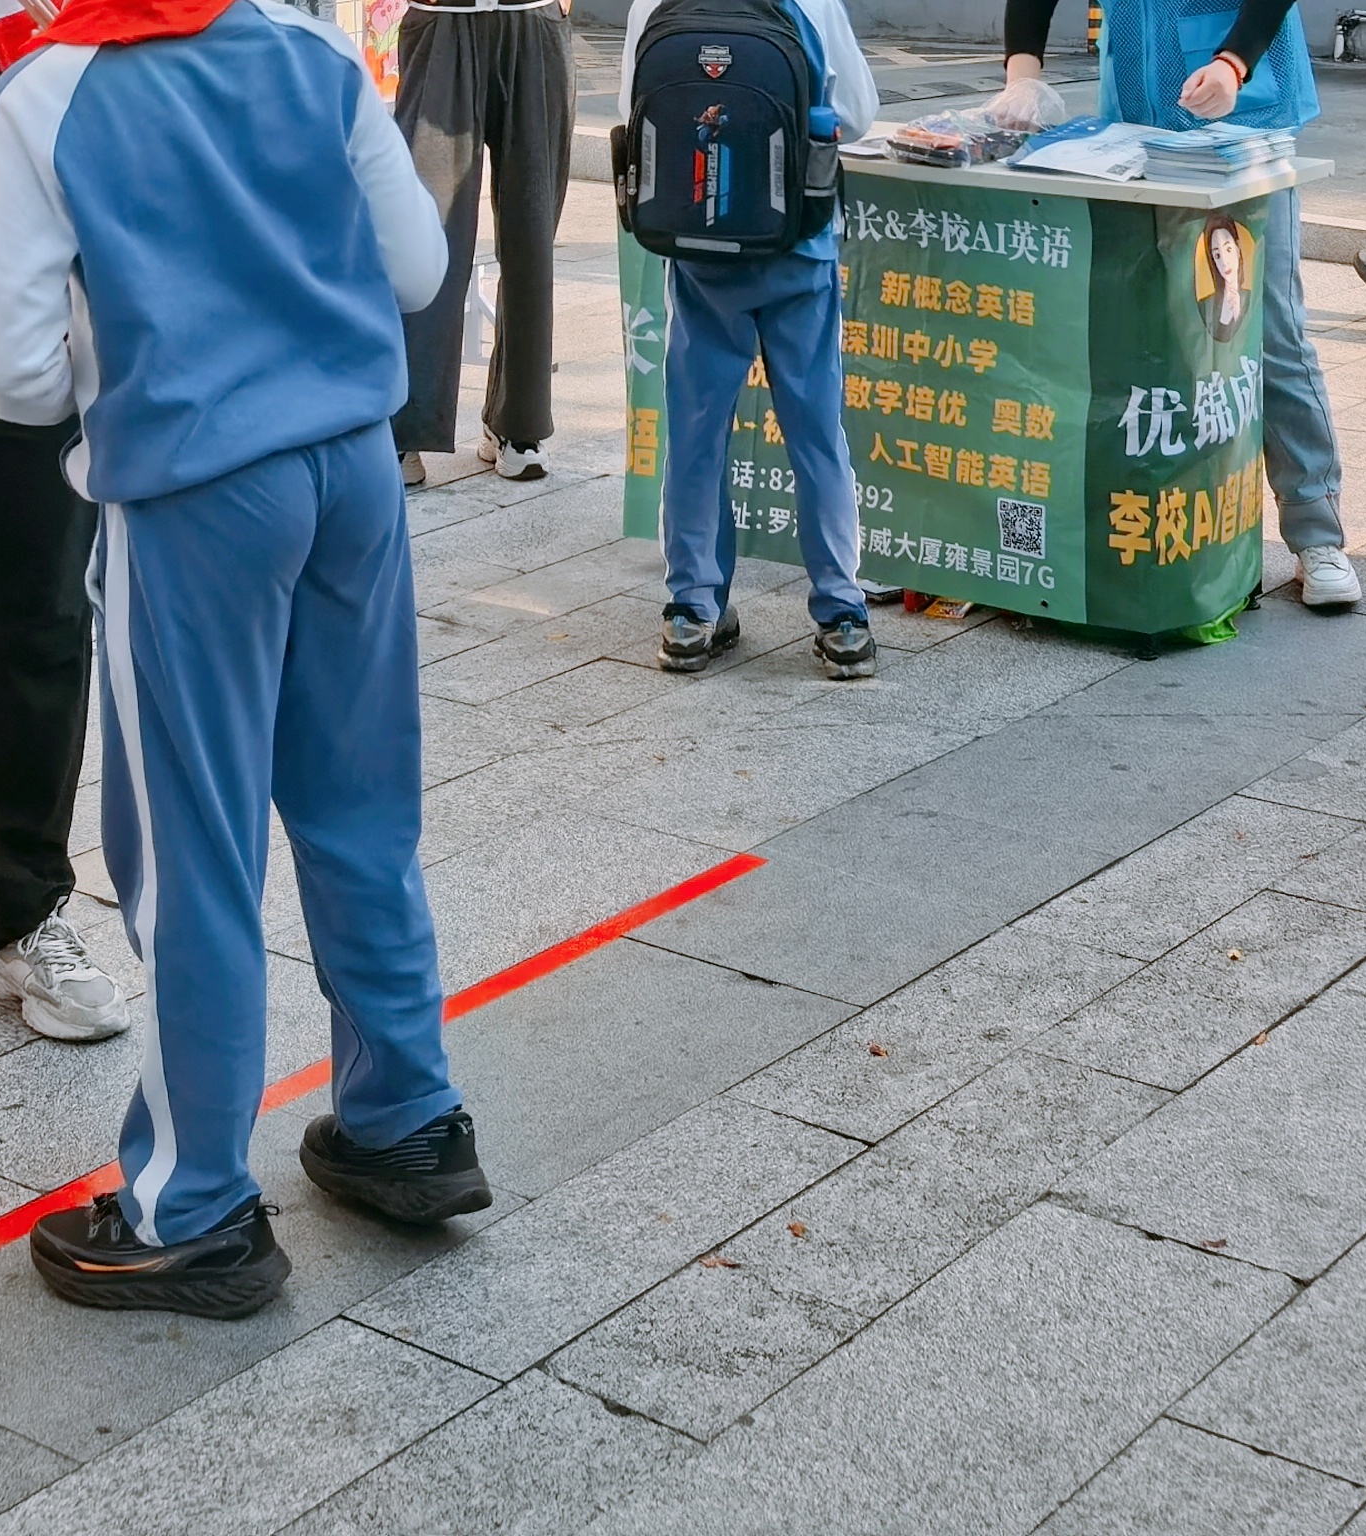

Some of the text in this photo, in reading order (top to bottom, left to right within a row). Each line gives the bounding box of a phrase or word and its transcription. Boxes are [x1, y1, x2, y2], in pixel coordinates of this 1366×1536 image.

[844, 200, 1072, 268] 长&李校AI英语
[881, 270, 1035, 326] 新概念英语
[841, 320, 998, 374] 深圳中小学
[844, 374, 1056, 441] 数学培优 奥数
[869, 432, 1051, 498] 人工智能英语
